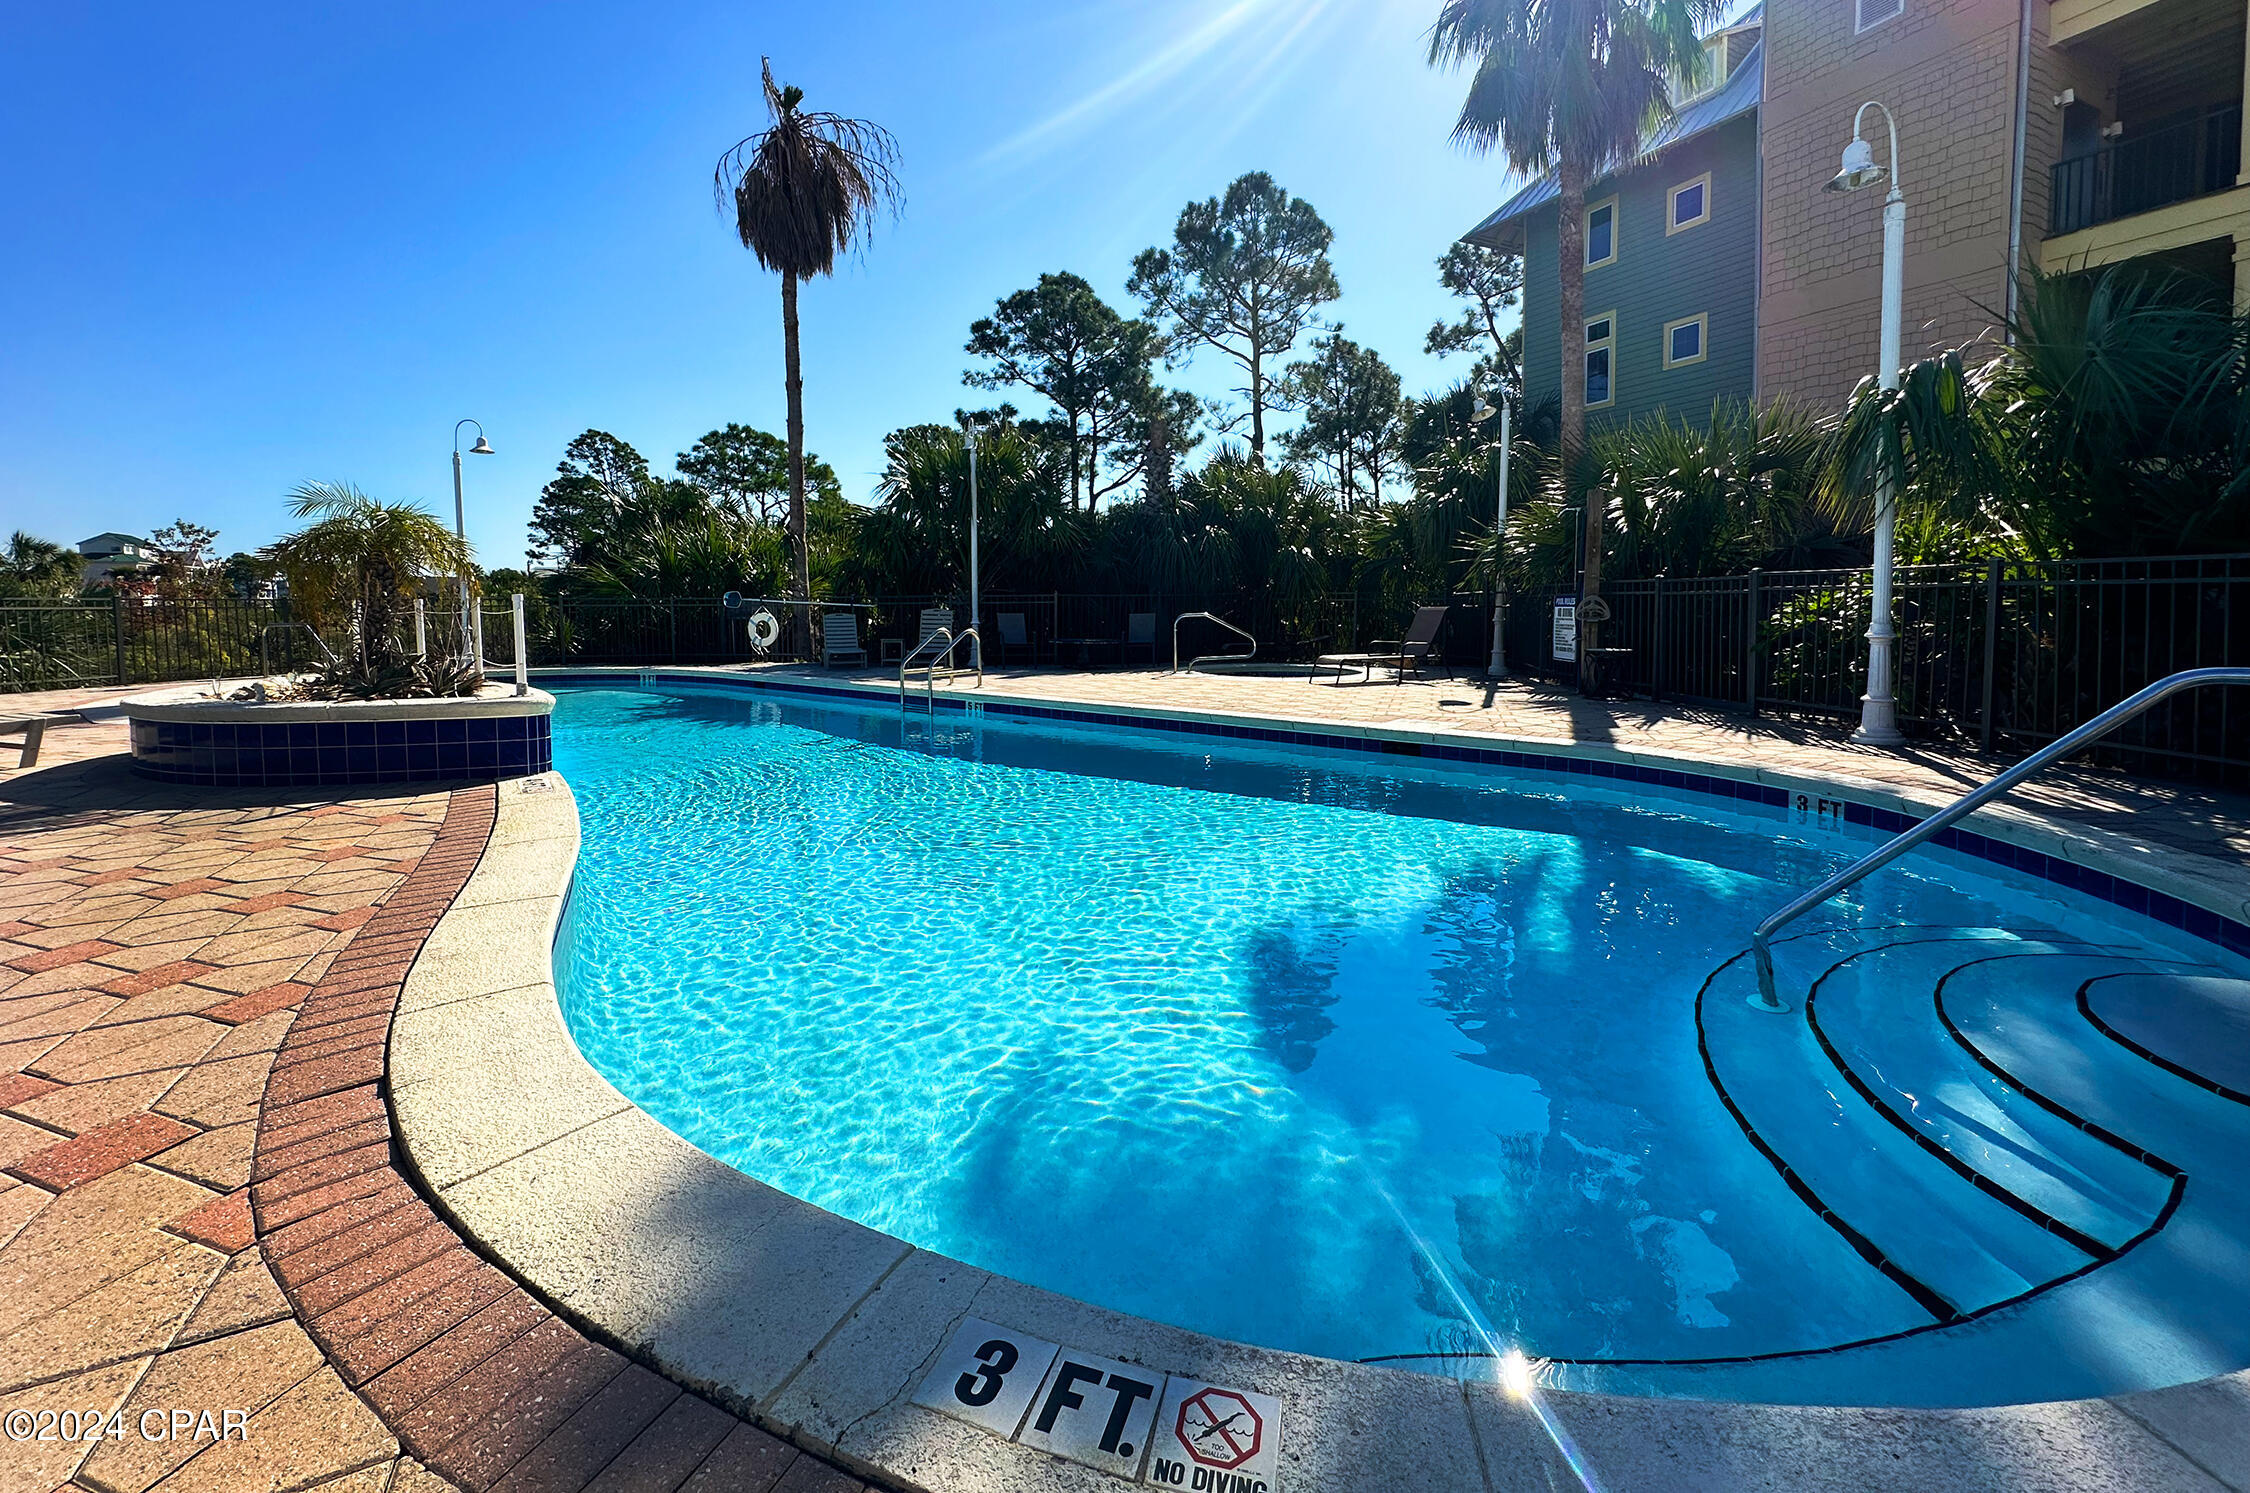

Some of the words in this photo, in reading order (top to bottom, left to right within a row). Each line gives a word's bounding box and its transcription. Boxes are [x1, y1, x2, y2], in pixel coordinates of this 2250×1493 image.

[1796, 794, 1809, 811] 3
[1817, 798, 1842, 818] FT
[954, 1339, 1019, 1407] 3
[1034, 1360, 1154, 1457] FT.
[1201, 1449, 1231, 1460] SHALLOW
[1211, 1442, 1225, 1452] TOO
[1153, 1458, 1186, 1486] NO
